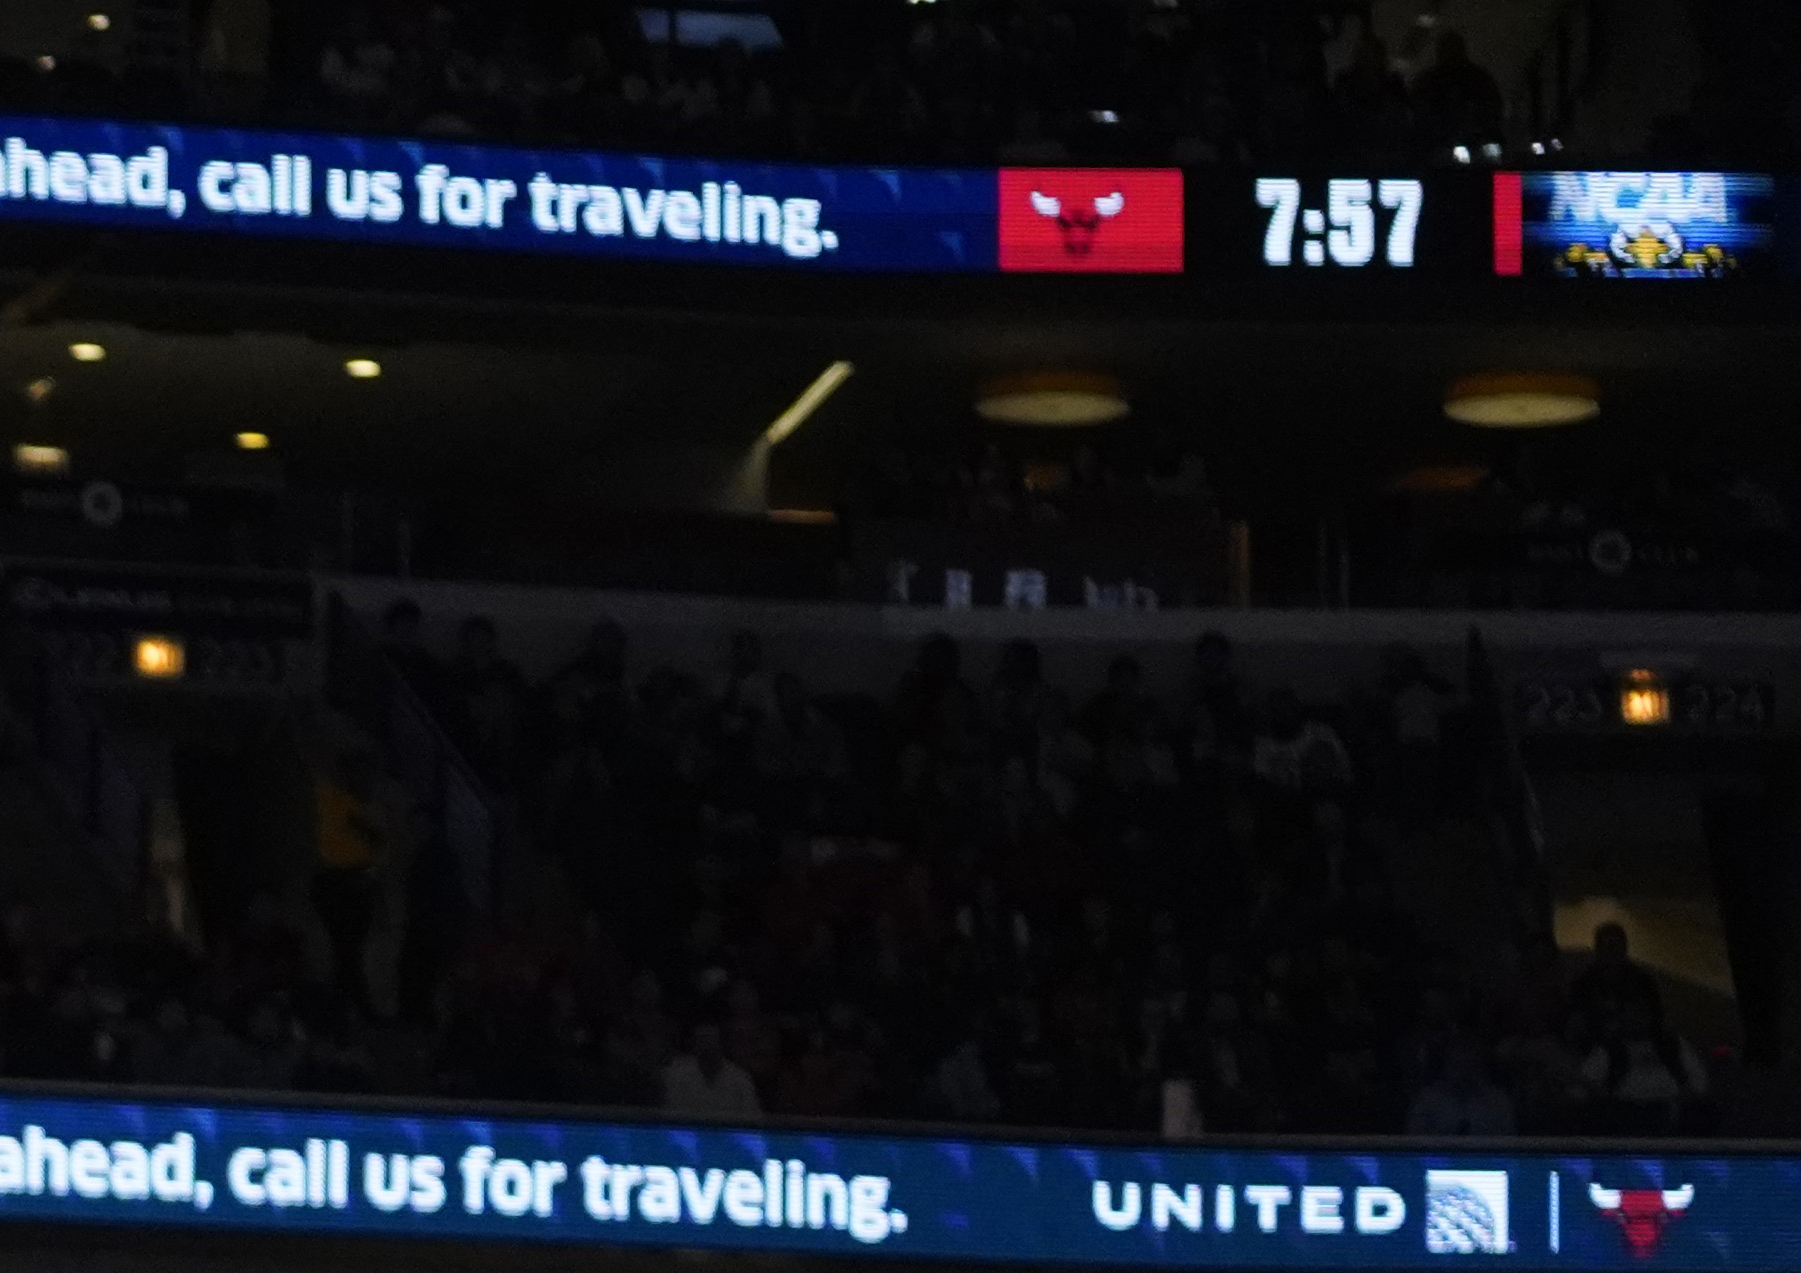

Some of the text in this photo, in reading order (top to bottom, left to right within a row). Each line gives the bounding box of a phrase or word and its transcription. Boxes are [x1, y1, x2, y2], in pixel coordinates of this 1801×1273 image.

[198, 154, 312, 216] call
[327, 168, 404, 222] us
[416, 164, 518, 228] for
[529, 172, 839, 259] traveling.
[1255, 177, 1424, 267] 7:57
[228, 1138, 350, 1209] call
[364, 1153, 447, 1213] us
[459, 1145, 568, 1218] for
[579, 1156, 909, 1244] traveling.
[1092, 1179, 1407, 1234] UNITED
